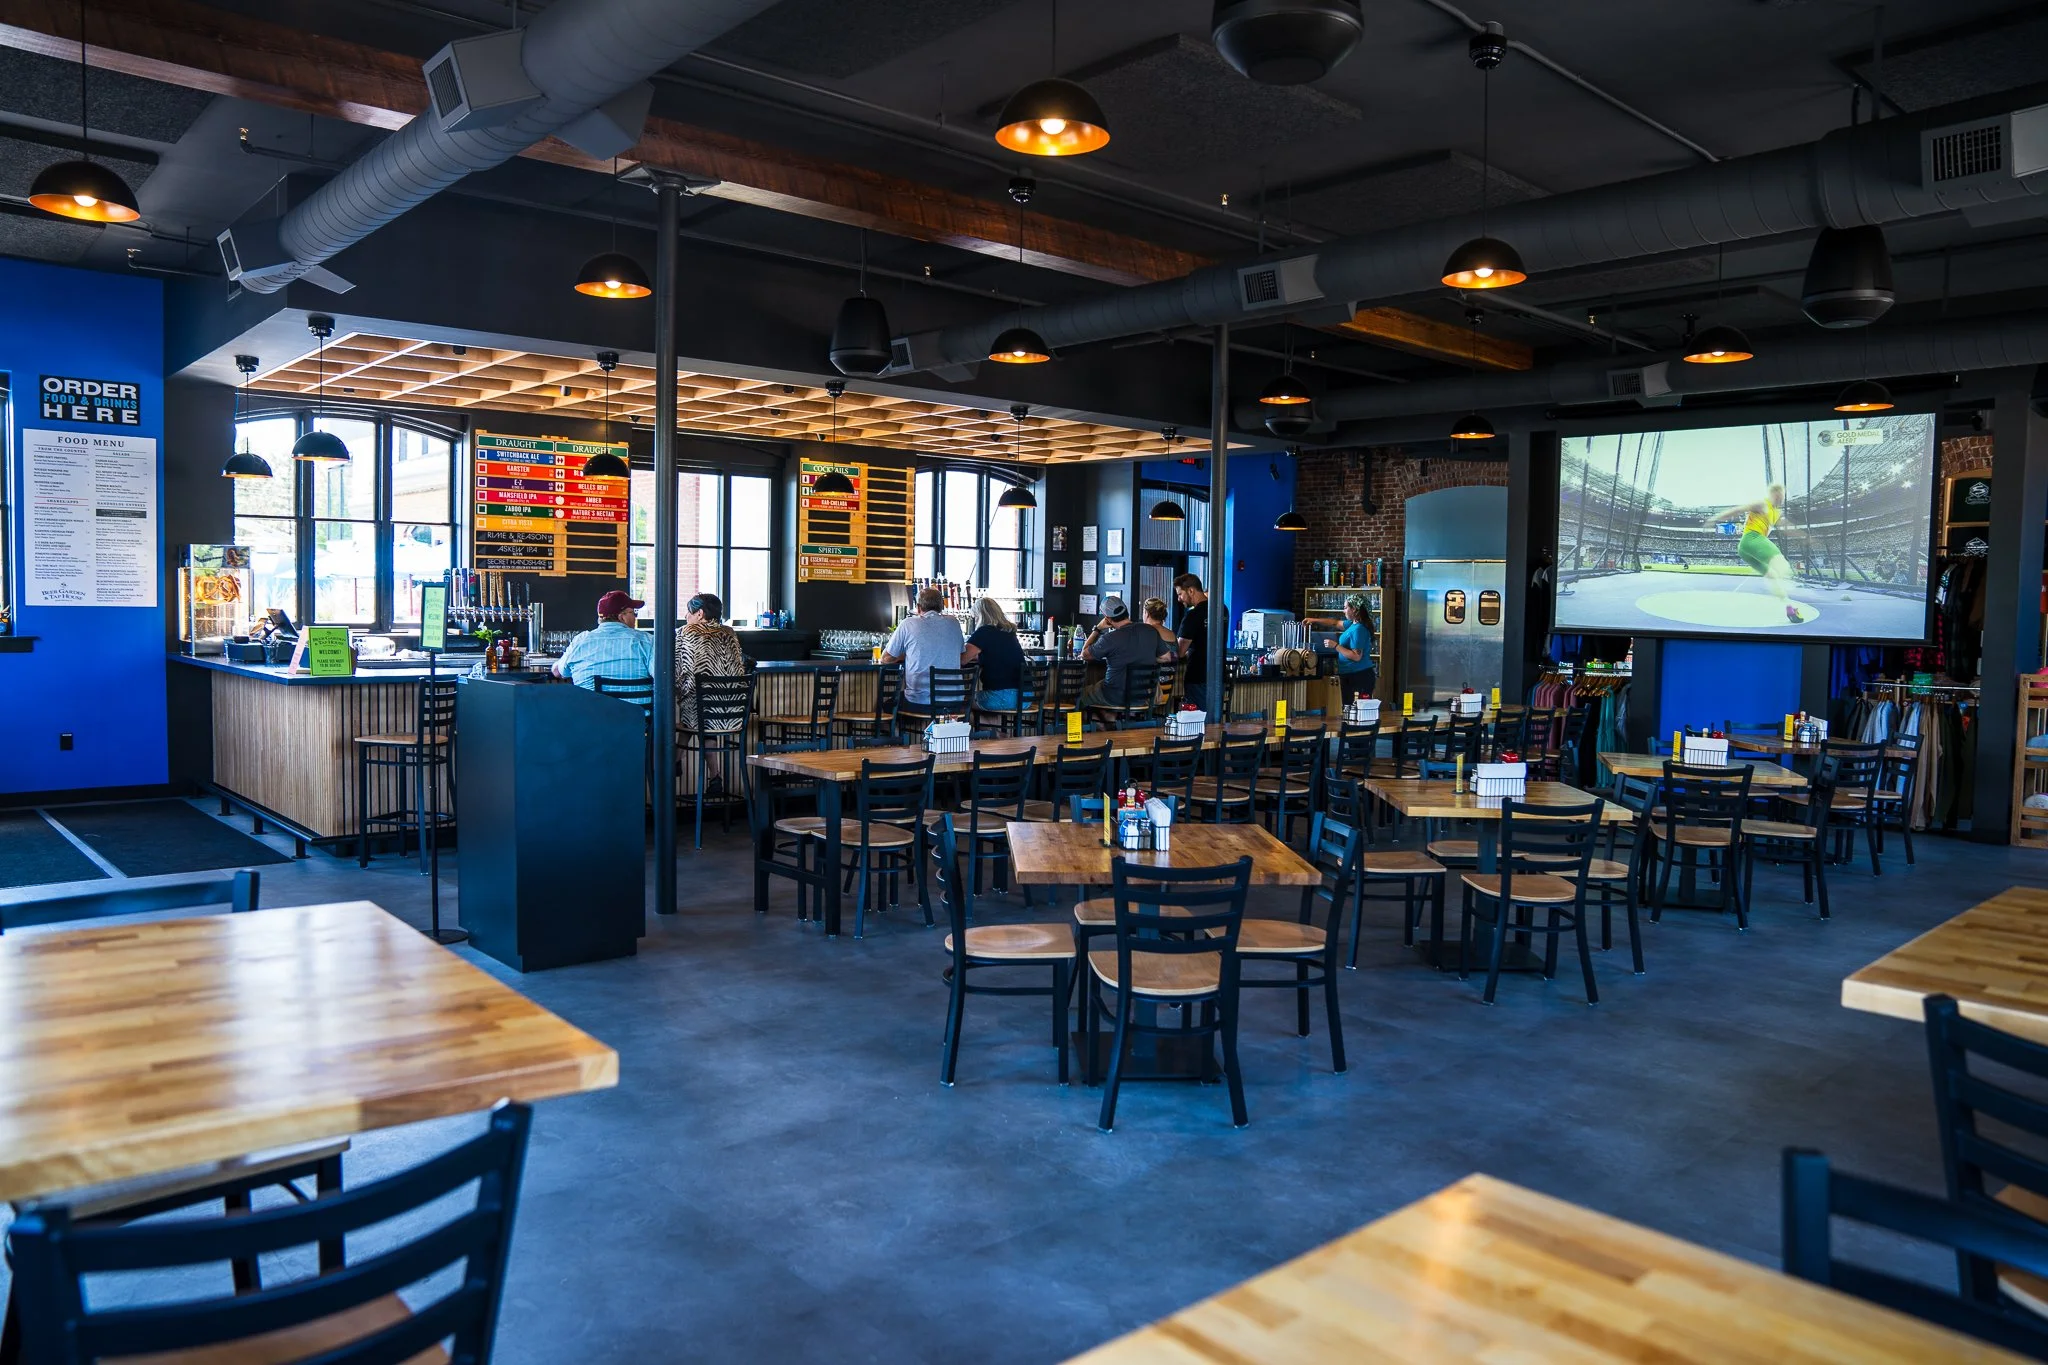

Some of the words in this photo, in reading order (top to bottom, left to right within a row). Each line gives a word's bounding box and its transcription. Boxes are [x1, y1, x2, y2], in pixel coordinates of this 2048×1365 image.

[43, 378, 137, 399] ORDER
[44, 393, 76, 404] FOOD
[80, 396, 90, 406] &
[94, 398, 138, 409] DRINKS
[44, 403, 138, 424] HERE
[58, 436, 88, 445] FOOD
[93, 439, 125, 448] MENU
[496, 438, 538, 448] DRAUGHT
[572, 444, 612, 454] DRAUGHT
[496, 450, 530, 459] SWITCHBACK
[506, 464, 530, 472] KARSTEN
[498, 492, 528, 500] MANSFIELD
